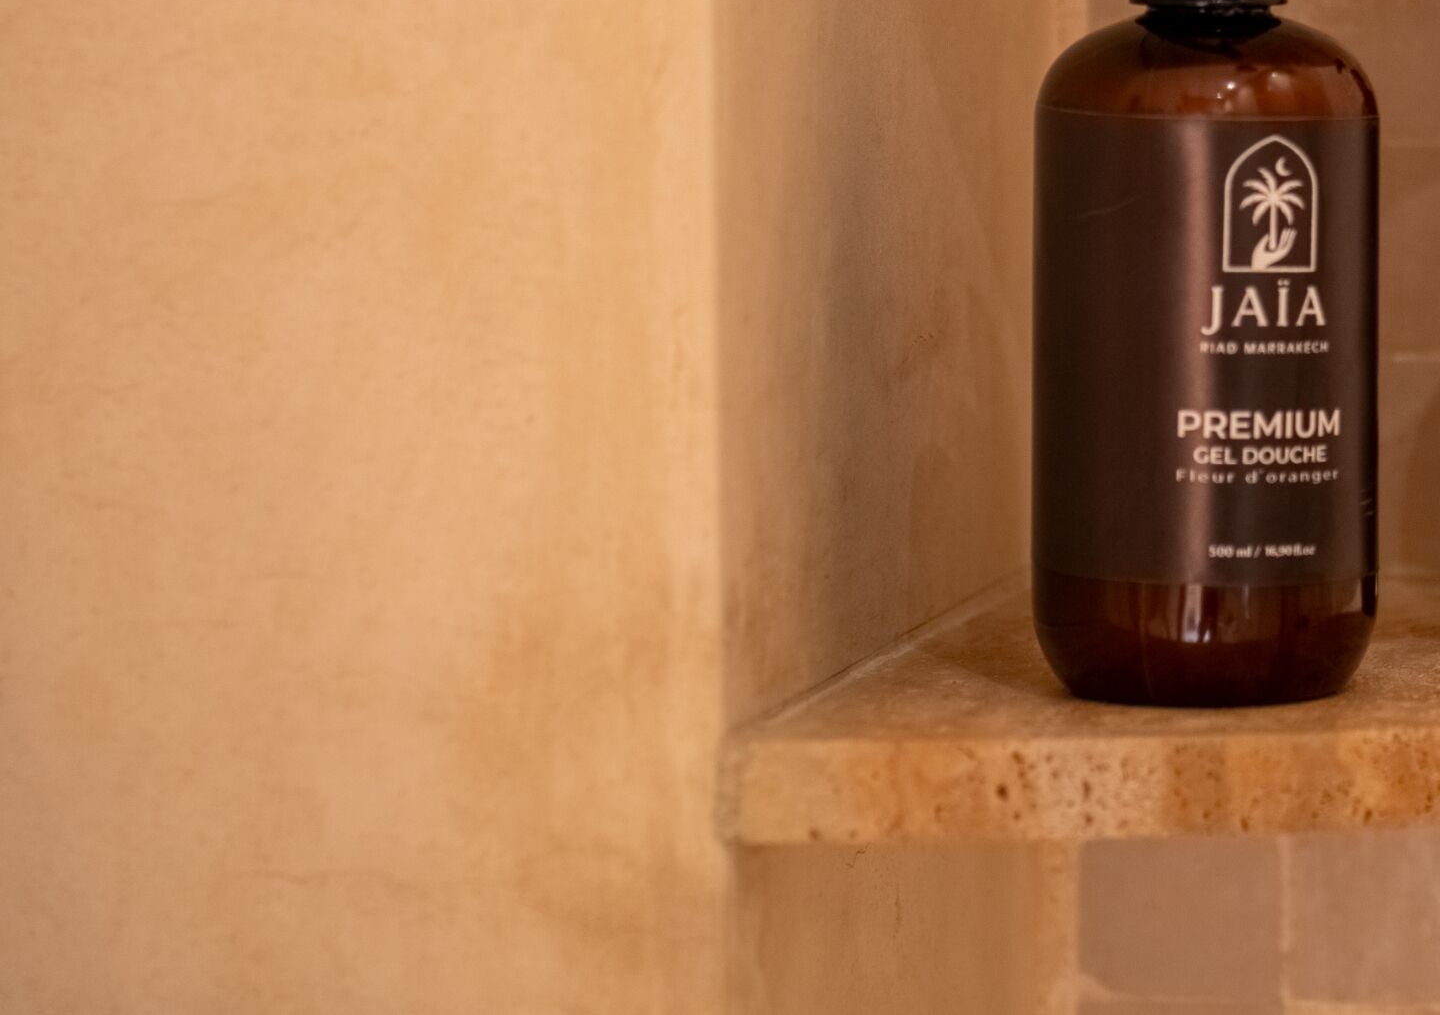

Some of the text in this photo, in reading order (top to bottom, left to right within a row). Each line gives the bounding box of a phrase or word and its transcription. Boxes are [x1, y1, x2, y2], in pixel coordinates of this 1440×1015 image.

[1201, 279, 1326, 335] JAÏA
[1200, 341, 1329, 355] RIAD MARRAKECH
[1177, 409, 1340, 439] PREMIUM
[1193, 445, 1327, 465] GEL DOUCHE
[1176, 469, 1339, 485] Fleur d'oranger
[1208, 545, 1234, 558] 500
[1235, 545, 1252, 558] ml
